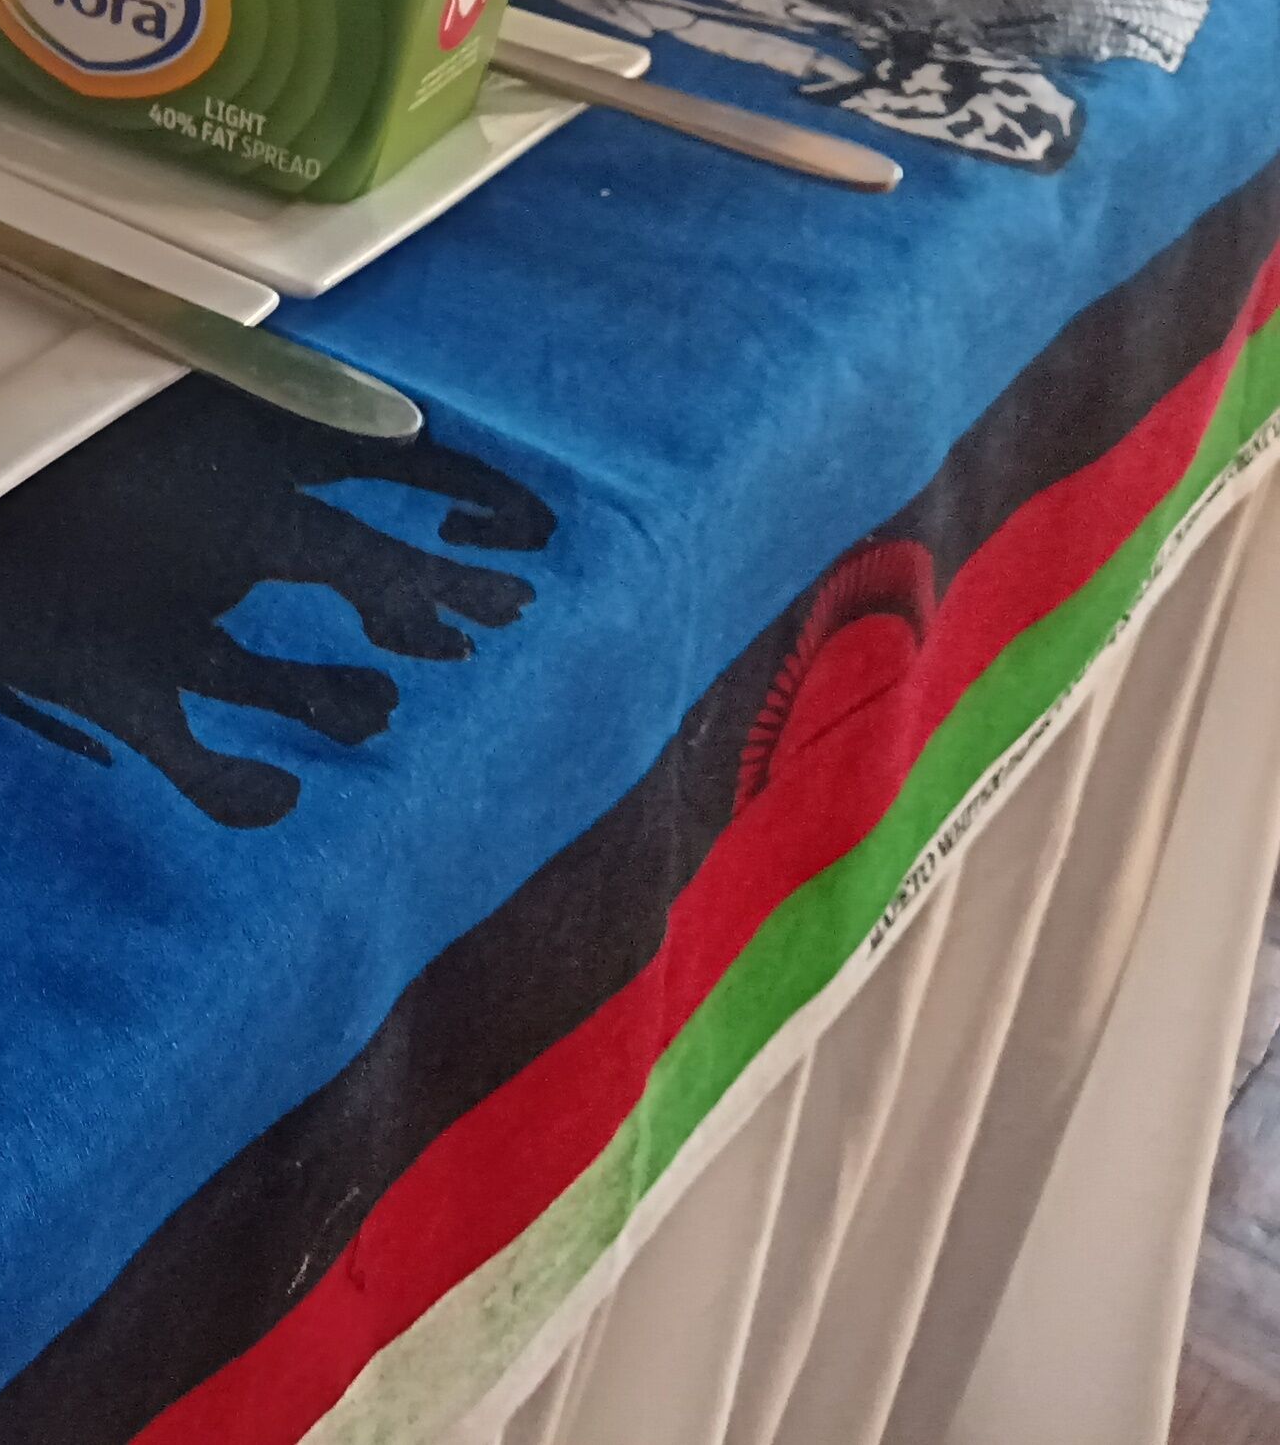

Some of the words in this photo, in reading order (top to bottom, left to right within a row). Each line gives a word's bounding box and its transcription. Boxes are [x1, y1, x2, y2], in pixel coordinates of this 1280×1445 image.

[148, 102, 198, 139] 40%
[201, 120, 239, 153] FAT
[240, 133, 323, 182] SPREAD
[204, 95, 268, 137] LIGHT
